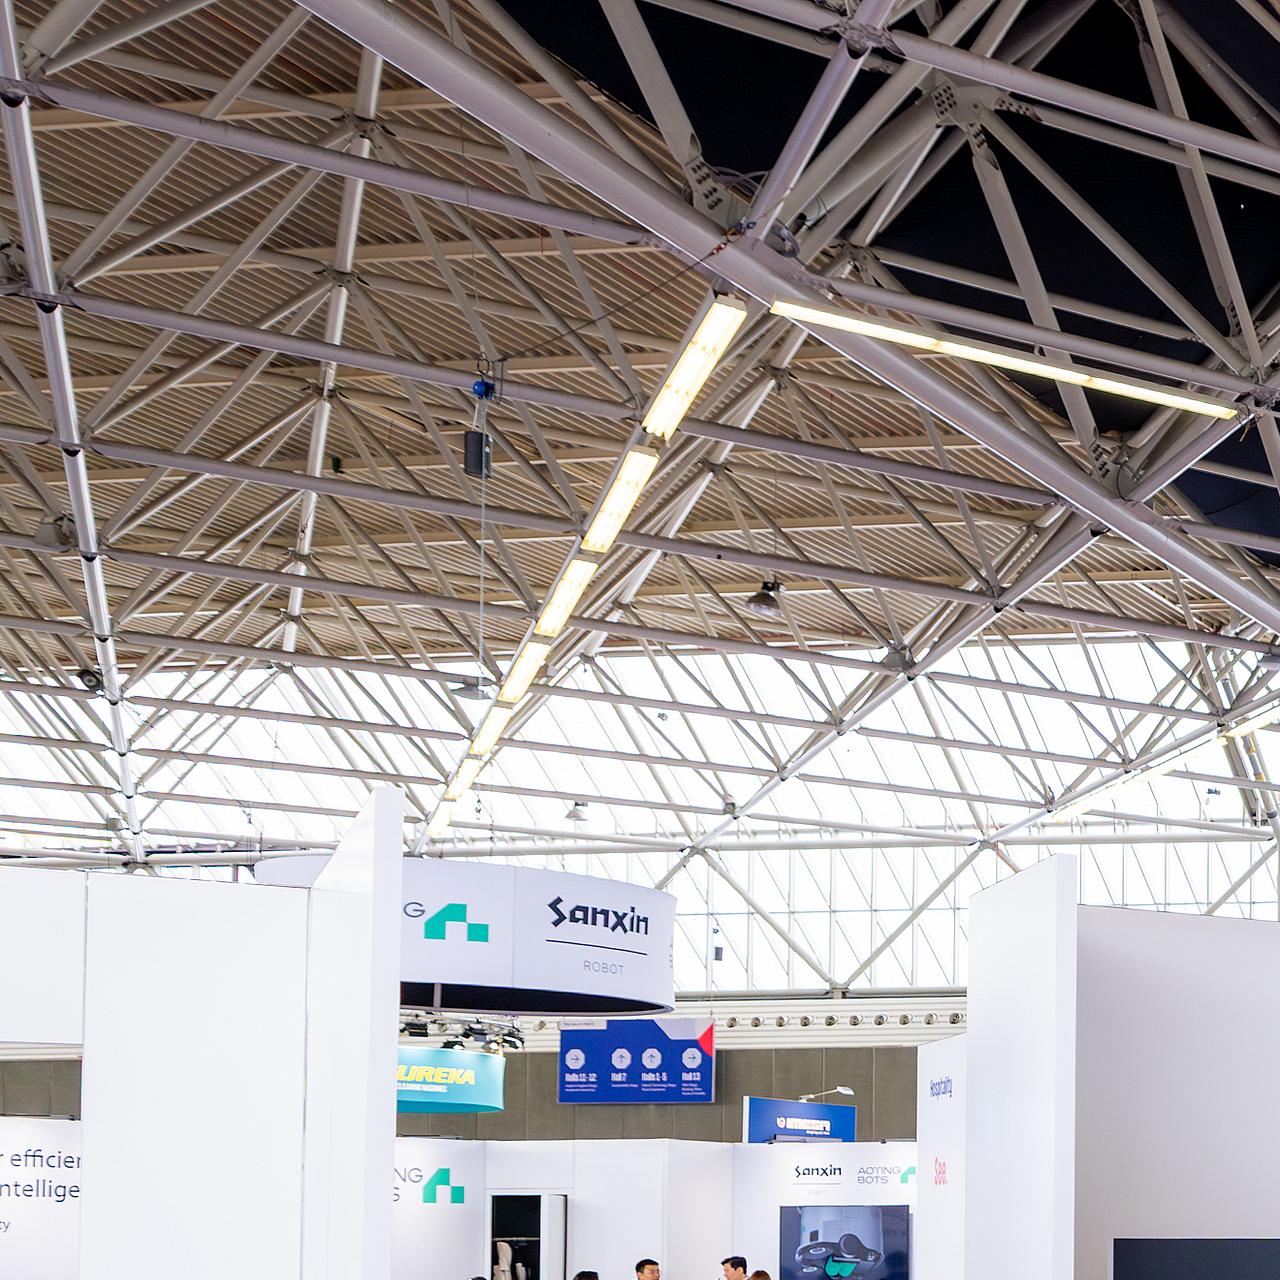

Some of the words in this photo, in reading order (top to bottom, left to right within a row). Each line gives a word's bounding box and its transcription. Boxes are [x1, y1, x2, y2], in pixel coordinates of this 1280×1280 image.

[403, 901, 426, 918] G
[547, 896, 649, 936] Sanxin
[584, 960, 625, 976] ROBOT
[397, 1064, 476, 1087] UREKA
[795, 1164, 842, 1178] Sanxin
[857, 1166, 901, 1176] AOTING
[857, 1175, 889, 1185] BOTS
